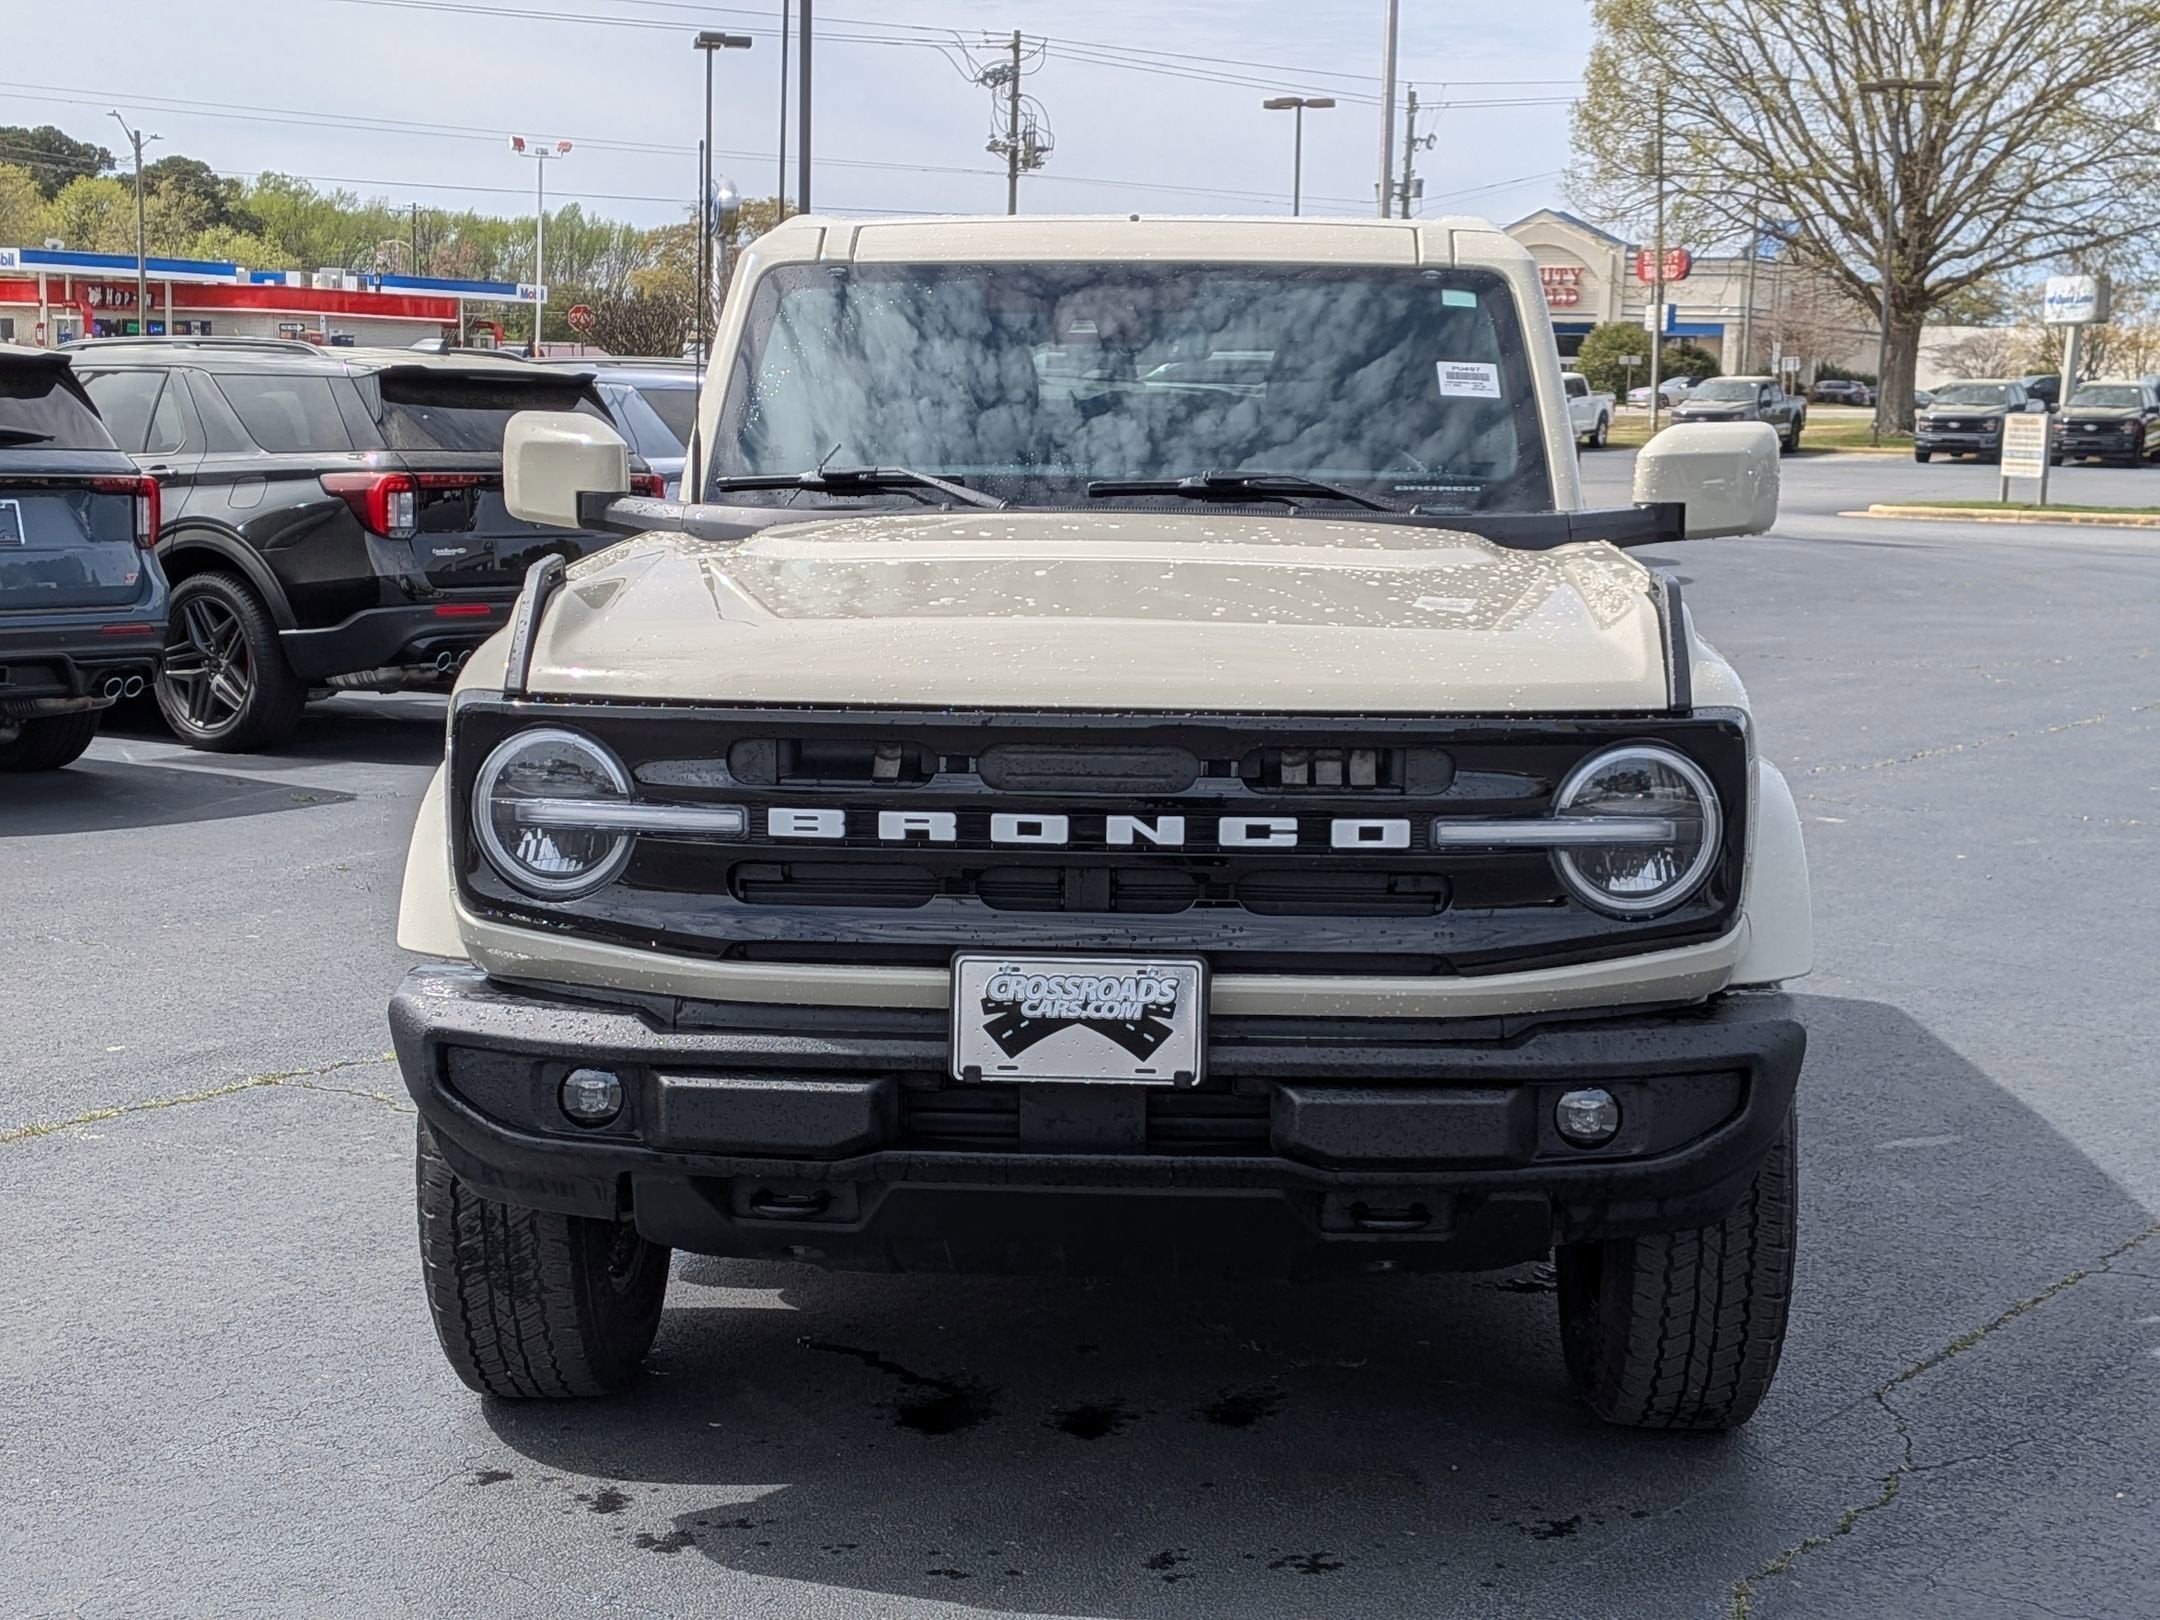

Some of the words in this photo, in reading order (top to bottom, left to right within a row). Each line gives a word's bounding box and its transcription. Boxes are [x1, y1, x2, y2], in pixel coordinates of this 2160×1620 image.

[106, 287, 152, 306] HOP-N
[520, 287, 545, 300] Mol
[768, 807, 1411, 848] BRONCO
[986, 974, 1178, 1004] CROSSROADS
[1021, 999, 1146, 1020] CARS.COM
